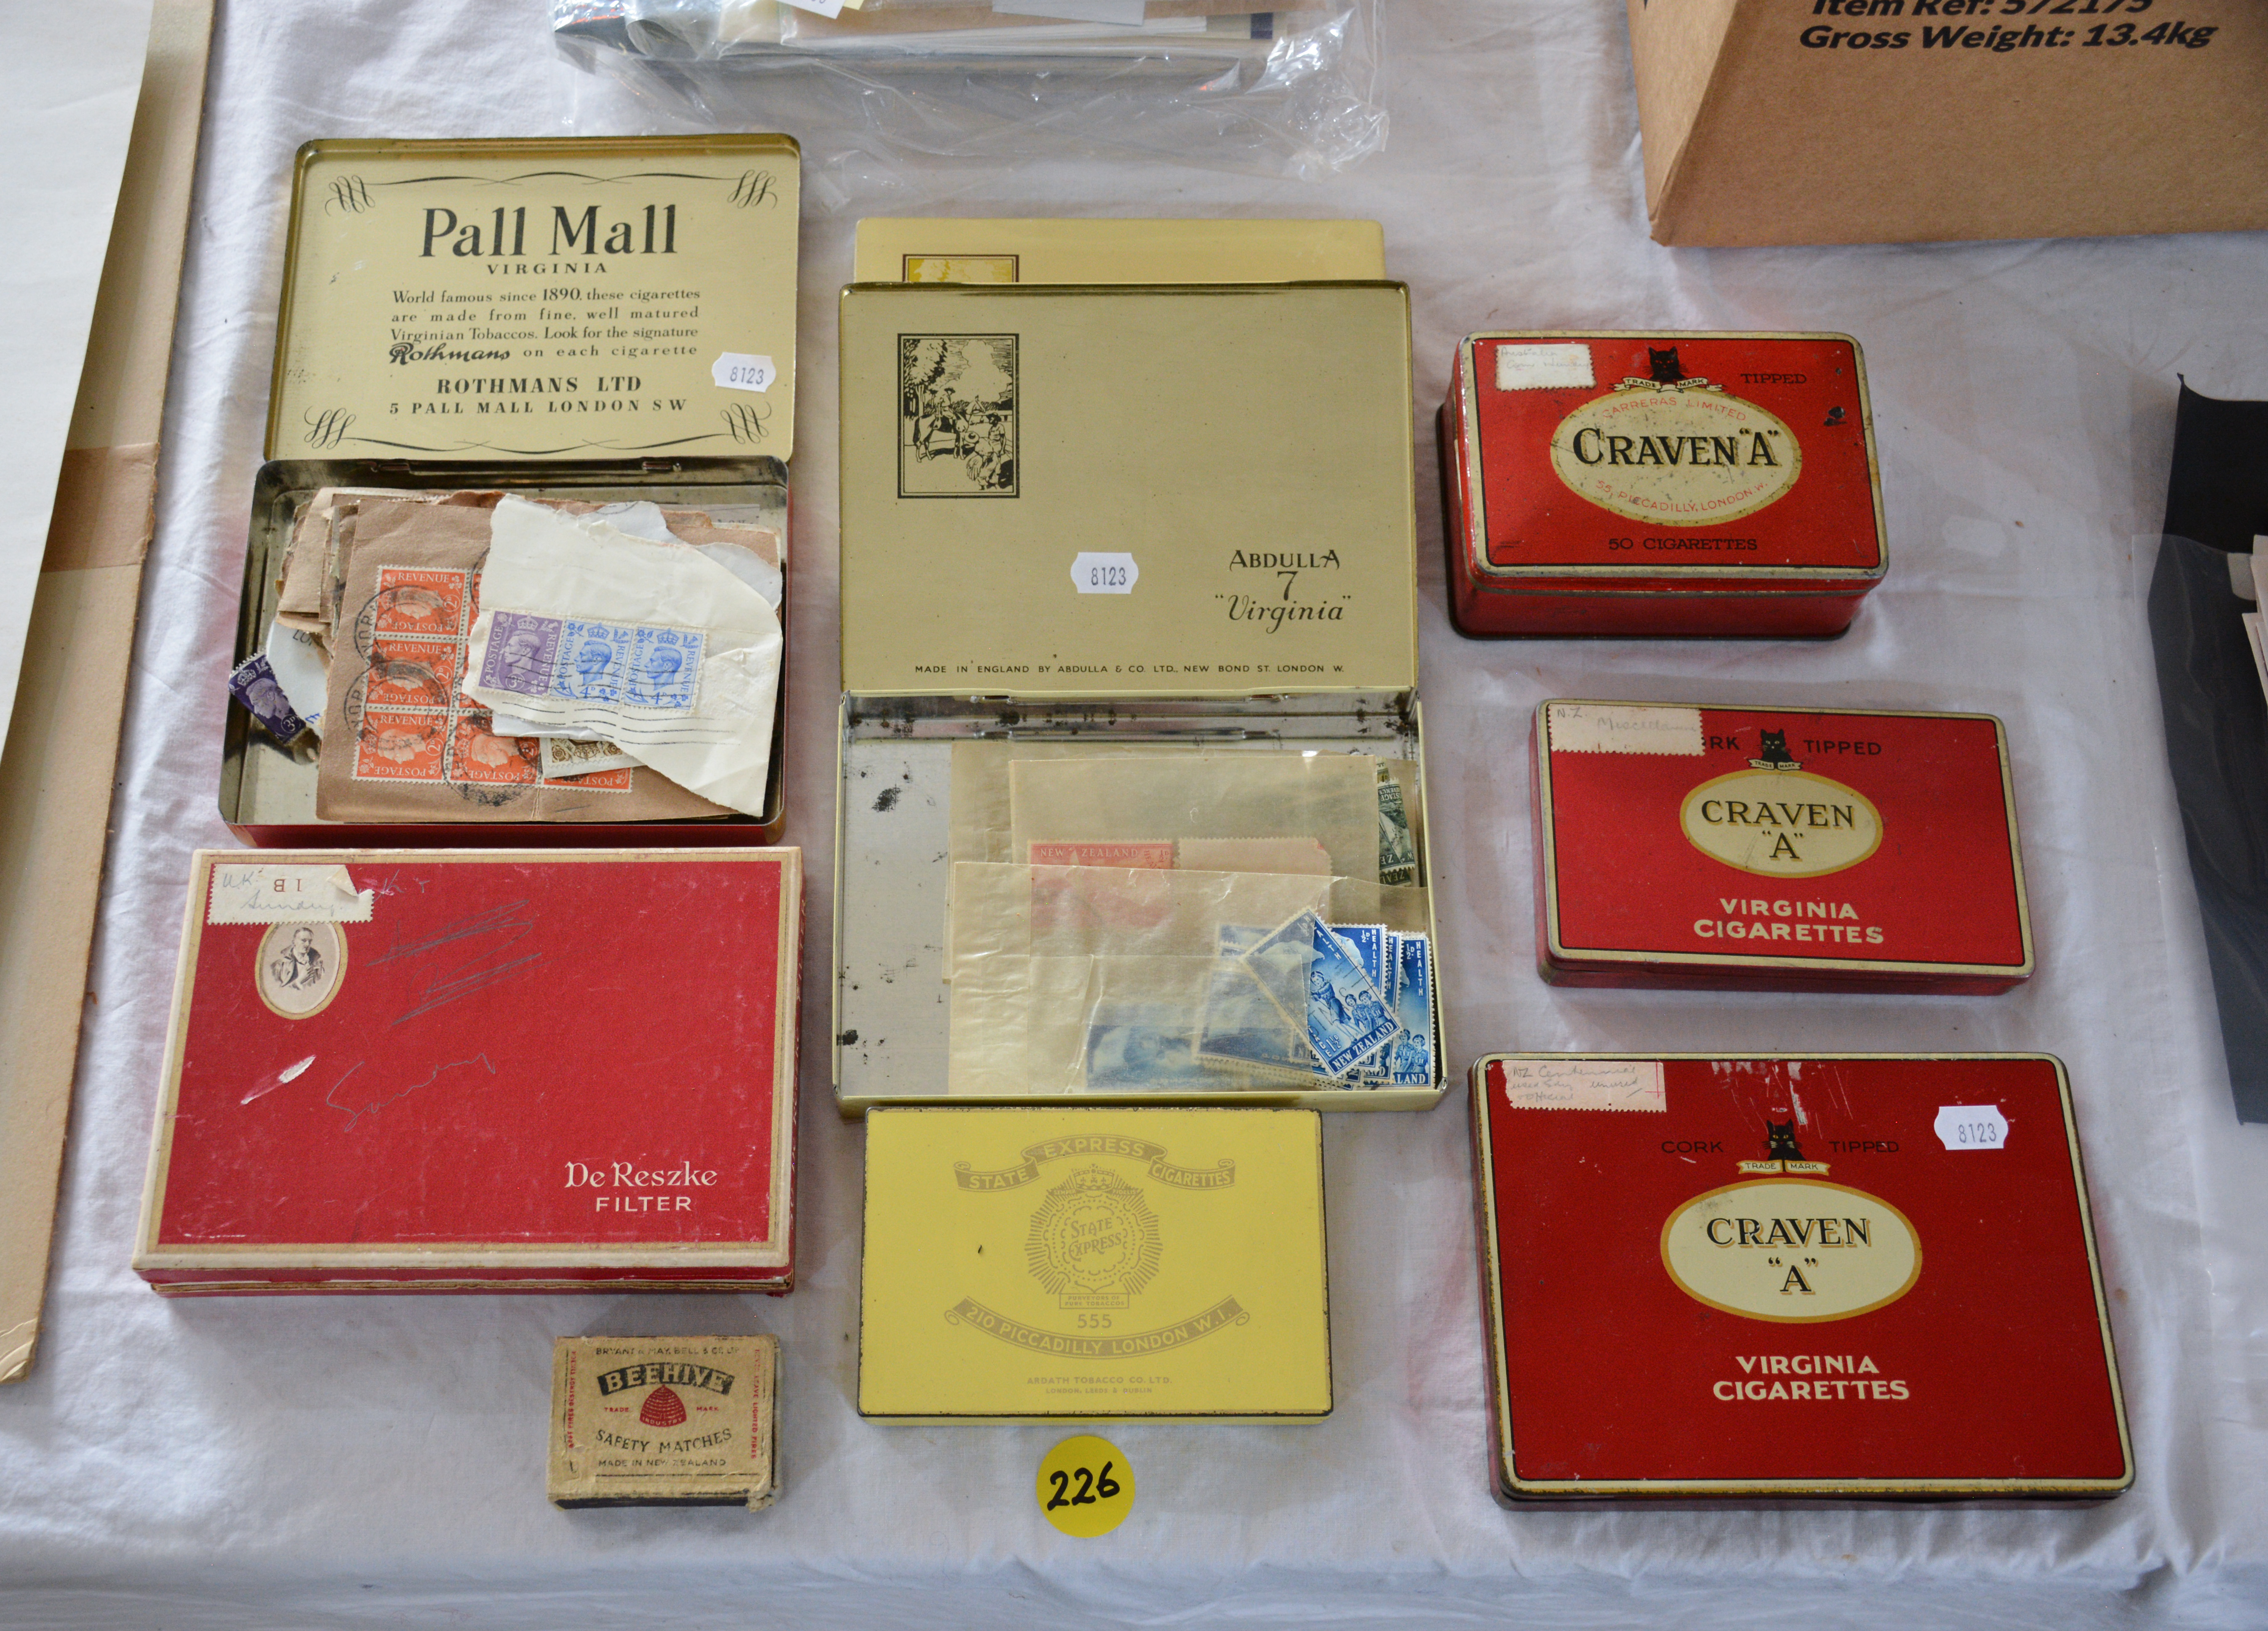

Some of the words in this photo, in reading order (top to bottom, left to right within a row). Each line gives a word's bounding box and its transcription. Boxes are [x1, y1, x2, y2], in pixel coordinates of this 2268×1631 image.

[1799, 24, 1911, 49] Gross
[1922, 24, 2075, 53] Weight:
[2082, 21, 2219, 48] 13.4kg
[419, 207, 526, 257] Pall
[548, 204, 677, 255] Mall
[487, 262, 607, 274] VIRGINIA
[394, 291, 434, 303] World
[441, 291, 492, 302] famous
[499, 291, 536, 302] since
[587, 288, 624, 300] these
[630, 289, 700, 303] cigarettes
[430, 310, 476, 322] made
[489, 309, 526, 320] from
[587, 307, 618, 319] well
[631, 306, 699, 318] matured
[391, 328, 463, 344] Virginian
[469, 328, 537, 339] Tobaccos.
[544, 326, 577, 339] Look
[583, 326, 602, 338] for
[607, 326, 627, 338] the
[633, 328, 698, 341] signature
[389, 342, 510, 365] Rothmans
[523, 349, 543, 357] on
[557, 345, 598, 357] each
[611, 346, 696, 359] cigarette
[437, 377, 578, 394] ROTHMANS
[597, 376, 641, 392] LTD
[730, 367, 764, 385] 8123
[1626, 379, 1656, 387] TRADE
[1679, 379, 1704, 387] MARK
[1741, 374, 1806, 384] TIPPED
[390, 403, 399, 414] 5
[412, 402, 463, 414] PALL
[477, 401, 533, 414] MALL
[548, 400, 640, 412] LONDON
[1603, 398, 1676, 418] CARRERAS
[1688, 400, 1746, 421] LIMITED
[1573, 427, 1737, 465] CRAVEN
[1609, 538, 1633, 550] 50
[1644, 538, 1757, 550] CIGARETTES
[1229, 550, 1339, 571] ABDULLA
[398, 572, 450, 583] REVENUE
[1091, 567, 1126, 587] 8123
[1277, 571, 1298, 601] 7
[1215, 595, 1350, 634] "Virginia"
[392, 621, 443, 632] POSTAGE
[389, 643, 441, 654] REVENUE
[485, 625, 503, 673] POSTAGE
[538, 630, 557, 686] REVENUE
[558, 636, 575, 680] POSTAGE
[610, 644, 626, 689] REVENUE
[680, 650, 696, 693] REVENUE
[384, 693, 435, 704] POSTAGE
[380, 715, 433, 726] REVENUE
[1803, 739, 1881, 755] TIPPED
[374, 766, 426, 777] POSTAGE
[468, 769, 520, 781] POSTAGE
[1701, 800, 1853, 828] CRAVEN
[1041, 848, 1064, 857] NEW
[1082, 848, 1137, 857] ZEALAND
[1719, 898, 1859, 920] VIRGINIA
[1694, 919, 1884, 944] CIGARETTES
[1416, 941, 1424, 997] HEALTH
[1332, 1052, 1353, 1070] NEW
[1353, 1022, 1394, 1056] ZEALAND
[1957, 1122, 1999, 1144] 8123
[1661, 1141, 1724, 1153] CORK
[1829, 1141, 1900, 1153] TIPPED
[564, 1161, 606, 1188] De
[611, 1161, 718, 1188] Reszke
[969, 1168, 1030, 1191] STATE
[1044, 1138, 1146, 1159] EXPRESS
[1152, 1163, 1231, 1187] CIGARETTES
[1790, 1163, 1819, 1171] MARK
[596, 1196, 691, 1212] FILTER
[1071, 1217, 1113, 1239] STATE
[1706, 1218, 1869, 1245] CRAVEN
[1068, 1233, 1122, 1262] EXPRESS
[966, 1307, 995, 1328] 210
[1000, 1323, 1102, 1355] PICCADILLY
[1113, 1327, 1189, 1354] LONDON
[1076, 1314, 1113, 1329] 555
[1735, 1356, 1880, 1374] VIRGINIA
[603, 1362, 728, 1393] BEEHIVE
[1713, 1380, 1910, 1401] CIGARETTES
[641, 1417, 682, 1426] INDUSTRY
[596, 1429, 650, 1452] SAFETY
[659, 1428, 732, 1453] MATCHES
[599, 1459, 627, 1467] MADE
[646, 1459, 668, 1467] NEW
[672, 1458, 726, 1466] ZEALAND
[1047, 1461, 1120, 1511] 226
